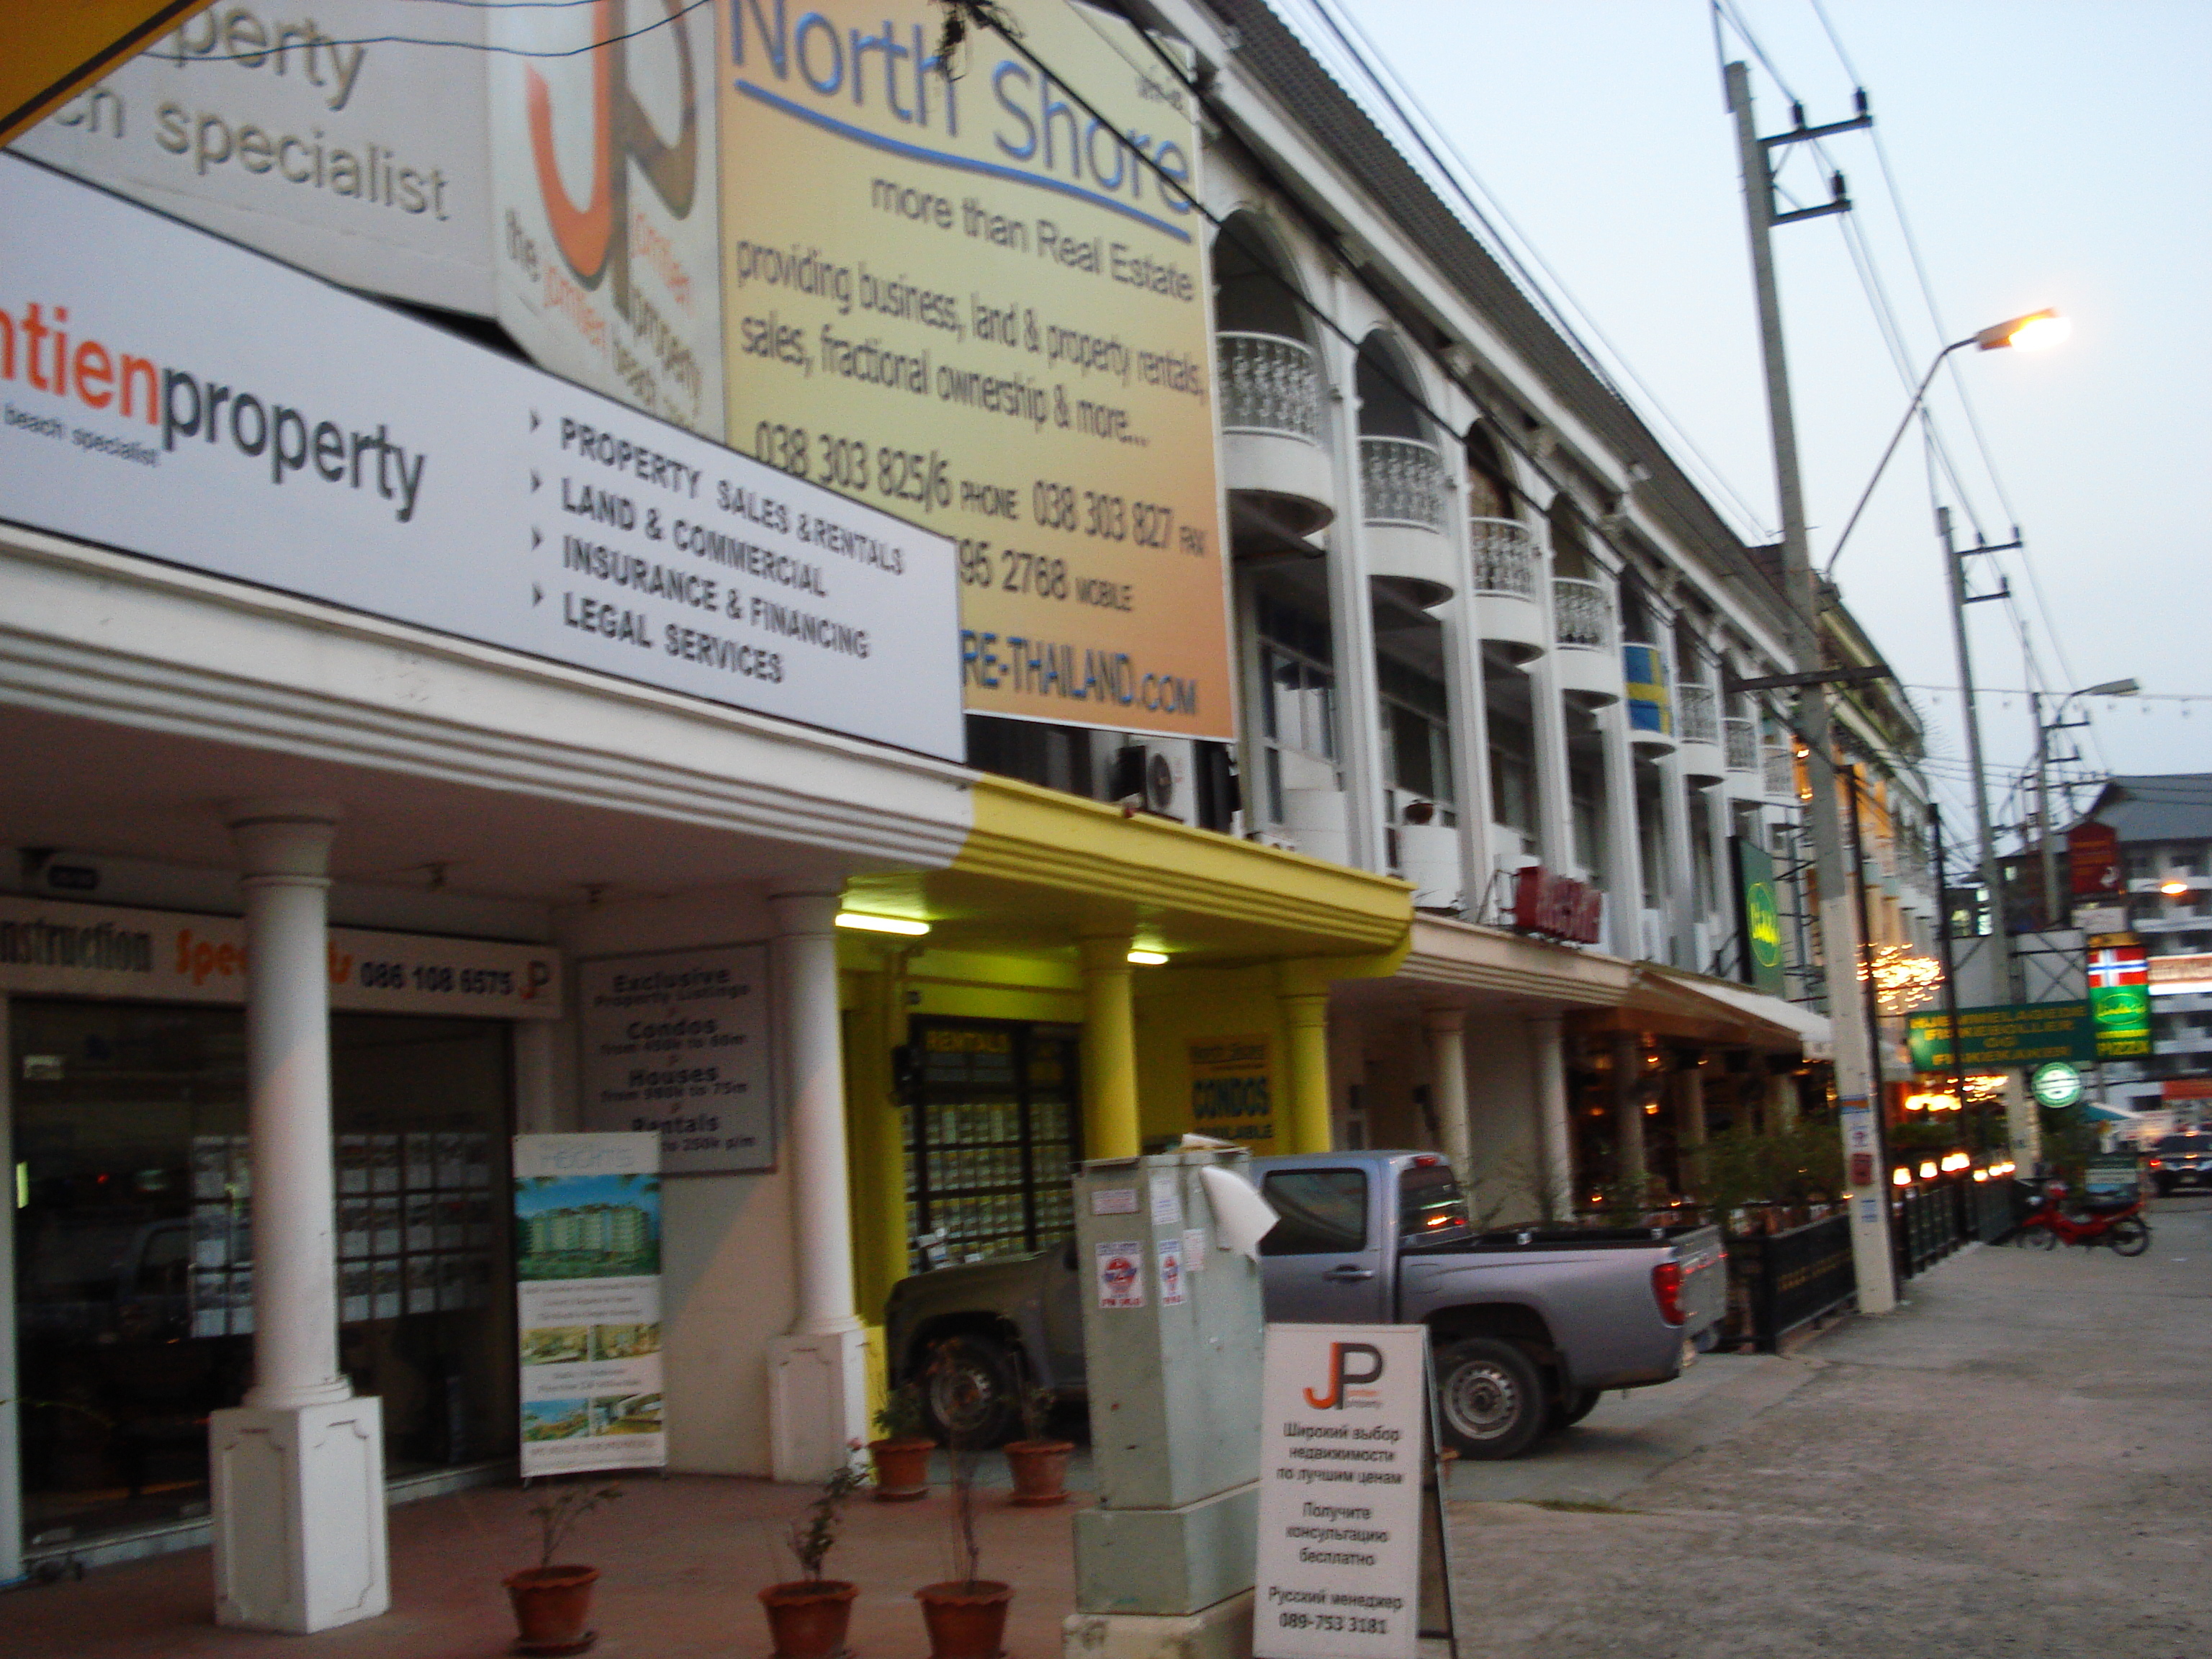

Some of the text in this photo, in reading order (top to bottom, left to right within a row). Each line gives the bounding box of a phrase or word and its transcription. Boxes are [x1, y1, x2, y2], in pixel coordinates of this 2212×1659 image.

[732, 0, 1192, 215] North Shore
[154, 101, 449, 222] specialist
[871, 177, 1195, 302] more than Real Estate
[736, 240, 853, 315] providing
[858, 261, 966, 344] business,
[971, 292, 1019, 350] land
[1023, 308, 1041, 354] &
[1046, 323, 1132, 386] property
[740, 310, 814, 379] sales,
[820, 323, 933, 397] fractional
[936, 363, 1049, 433] ownership
[1053, 384, 1070, 430] &
[559, 416, 702, 500] PROPERTY
[716, 480, 791, 535] SALES
[753, 419, 1208, 559] 038 303 825/6 PHONE 038 303 827 FAX
[560, 477, 828, 598] LAND & COMMERCIAL
[1000, 547, 1069, 602] 2768
[1074, 575, 1134, 613] MOBILE
[562, 534, 871, 660] INSURANCE & FINANCING
[562, 590, 784, 685] LEGAL SERVICES
[961, 628, 1197, 717] RE-THAILAND.COM
[626, 1017, 719, 1040] Condos
[1303, 1341, 1383, 1411] JP
[1283, 1421, 1401, 1445] Широкий выбор
[1289, 1447, 1395, 1463] недвижимости
[1297, 1467, 1354, 1485] лучшим
[1357, 1470, 1404, 1486] ценам
[1285, 1525, 1391, 1545] консультацию
[1302, 1501, 1372, 1523] Получите
[1268, 1585, 1405, 1614] Русский менеджер
[1298, 1547, 1376, 1567] бесплатно
